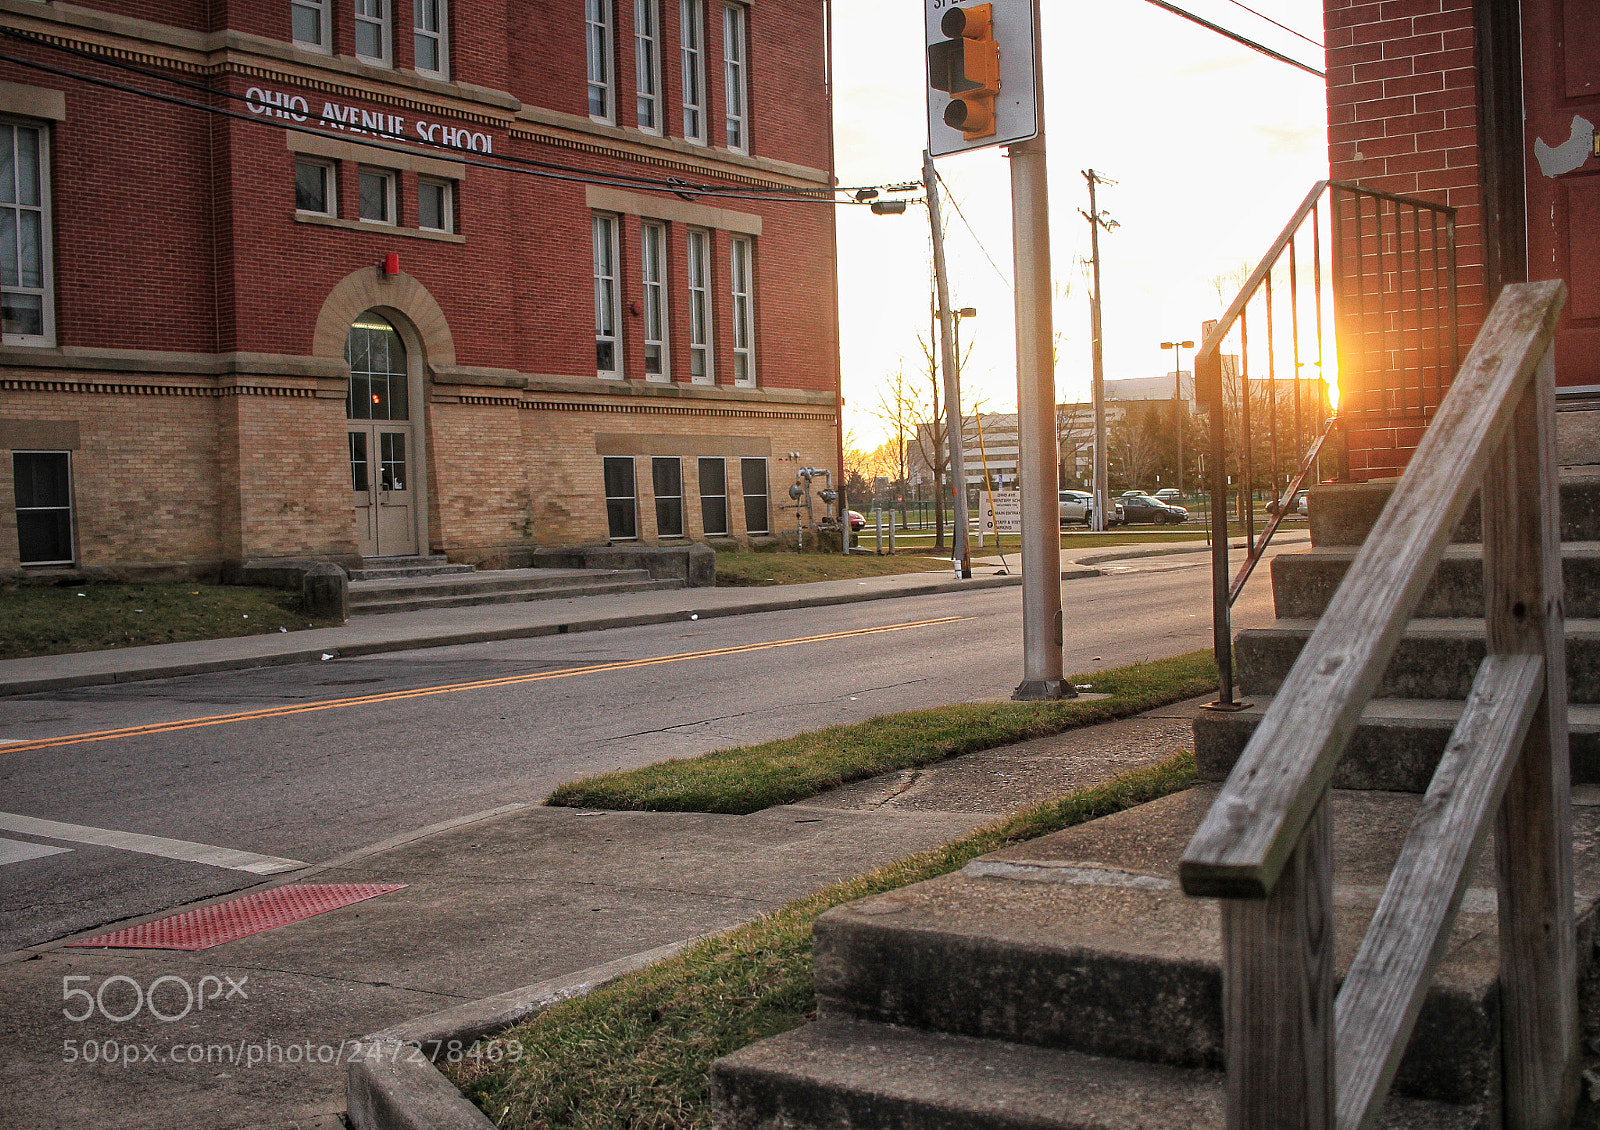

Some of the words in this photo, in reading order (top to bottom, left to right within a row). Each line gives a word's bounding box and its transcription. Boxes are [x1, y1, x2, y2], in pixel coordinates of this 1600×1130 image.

[245, 87, 309, 122] OHIO
[320, 102, 406, 142] AVENUE
[416, 120, 493, 156] SCHOOL
